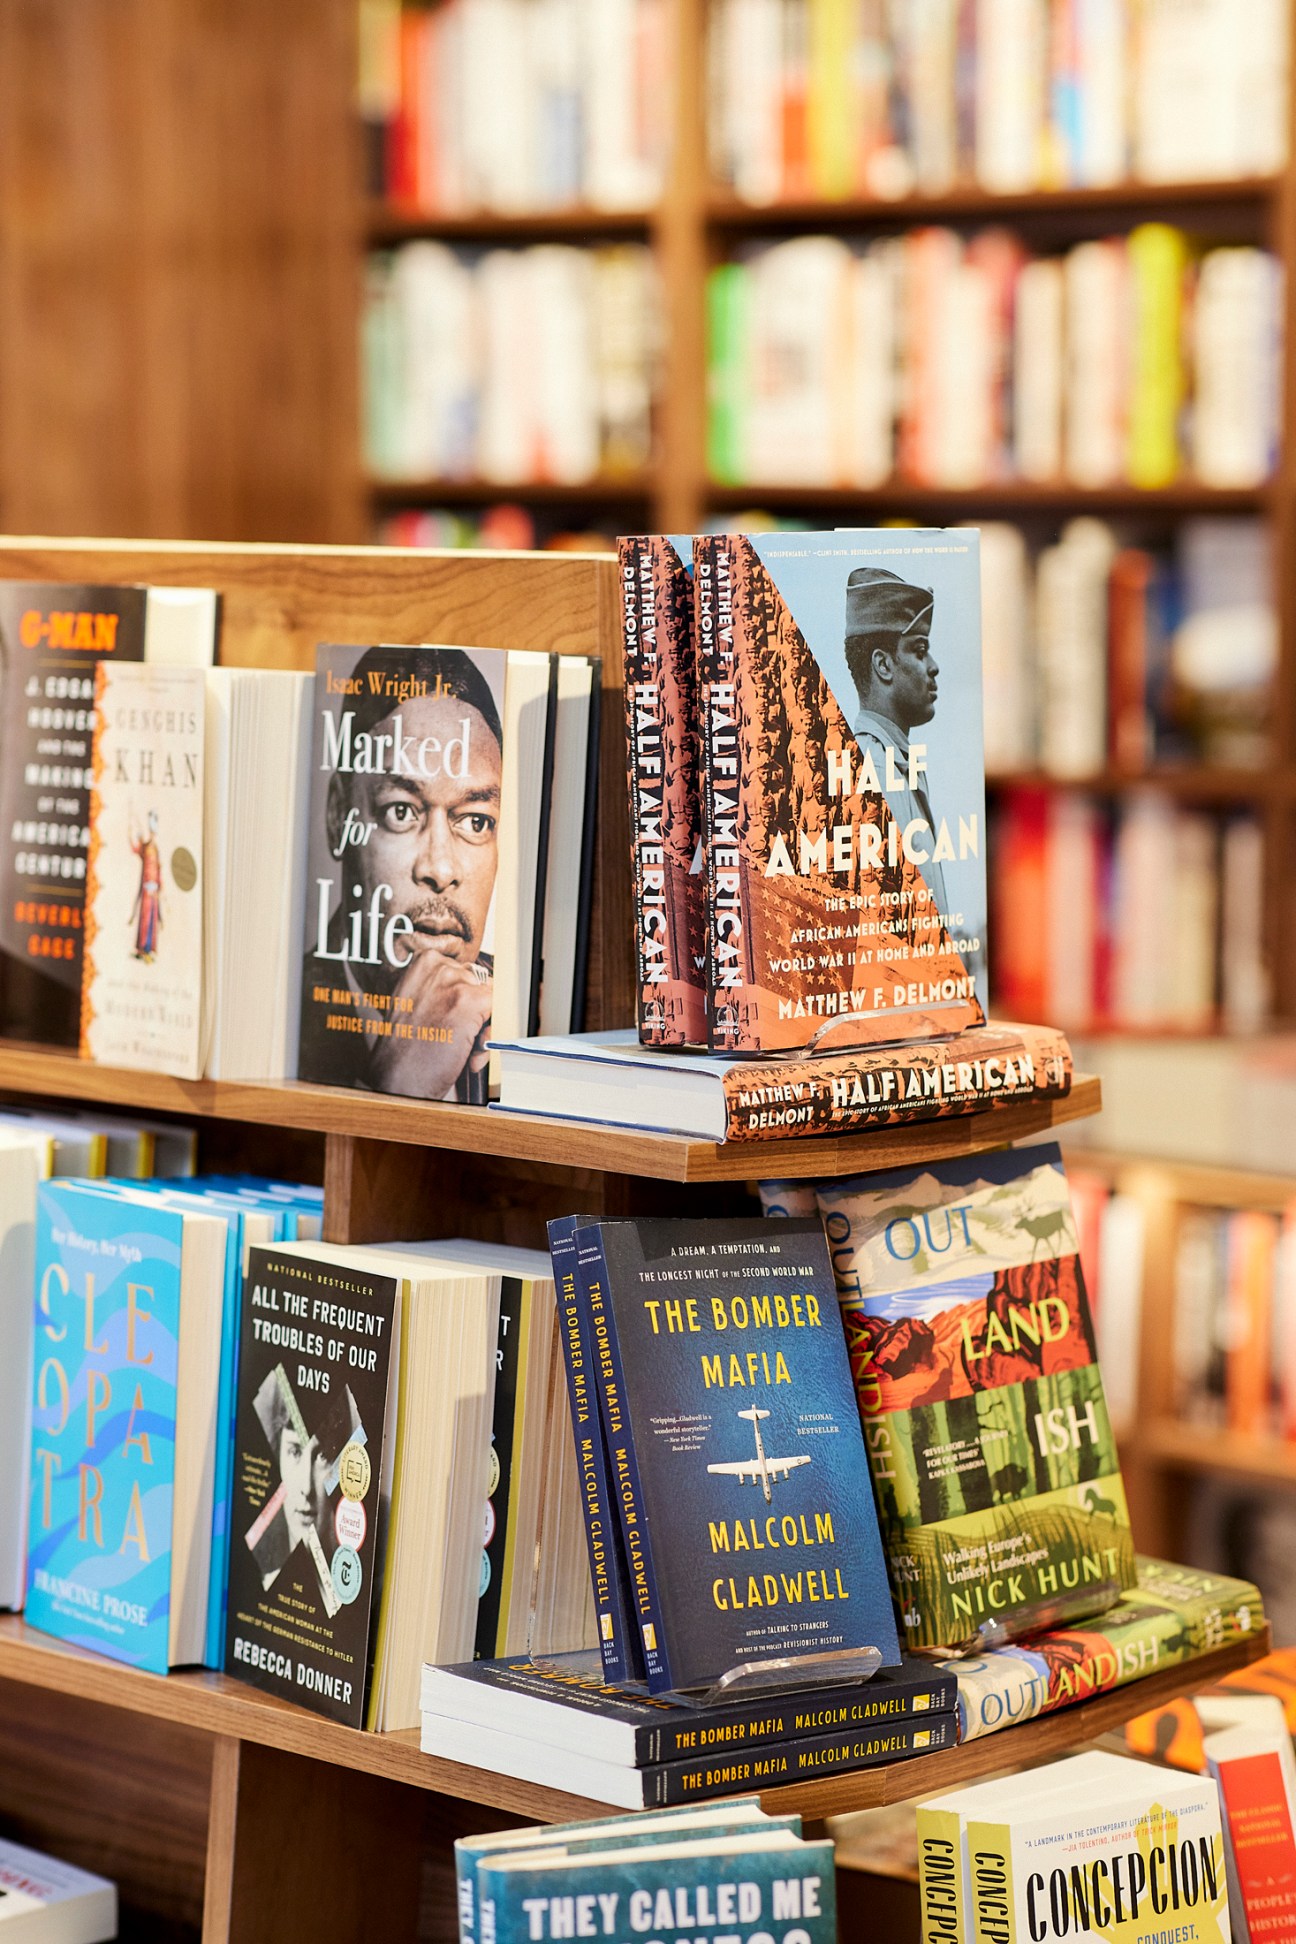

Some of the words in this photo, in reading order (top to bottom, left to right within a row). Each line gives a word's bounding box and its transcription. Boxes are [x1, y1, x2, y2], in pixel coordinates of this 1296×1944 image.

[623, 566, 638, 656] DELMONT
[639, 555, 657, 644] MATTHEW
[699, 564, 714, 656] DELMONT
[716, 552, 733, 643] MATTHEW
[20, 610, 118, 651] G-MAN
[643, 652, 657, 666] F.
[720, 651, 733, 665] F.
[326, 669, 363, 695] Isaac
[368, 671, 428, 704] Wright
[433, 674, 457, 701] Jr.
[320, 710, 472, 778] Marked
[635, 684, 661, 774] HALF
[710, 684, 737, 775] HALF
[115, 749, 198, 788] KHAN
[827, 744, 927, 796] HALF
[333, 807, 378, 856] for
[764, 814, 978, 877] AMERICAN
[638, 790, 669, 983] AMERICAN
[713, 792, 743, 987] AMERICAN
[825, 897, 846, 911] THE
[849, 894, 876, 908] EPIC
[880, 890, 914, 906] STORY
[917, 889, 934, 902] OF
[313, 878, 414, 968] Life
[790, 924, 844, 943] AFRICAN
[845, 919, 908, 939] AMERICANS
[911, 912, 964, 933] FIGHTING
[769, 957, 815, 973] WORLD
[819, 954, 843, 967] WAR
[847, 951, 857, 965] II
[860, 950, 873, 964] AT
[877, 946, 910, 962] HOME
[912, 942, 935, 958] AND
[938, 938, 980, 956] ABROAD
[313, 986, 330, 1003] ONE
[363, 992, 391, 1009] FIGHT
[394, 996, 413, 1012] FOR
[778, 989, 865, 1019] MATTHEW
[873, 987, 887, 1008] F.
[894, 976, 976, 1006] DELMONT
[326, 1014, 363, 1033] JUSTICE
[365, 1018, 392, 1037] FROM
[395, 1023, 413, 1039] THE
[417, 1026, 453, 1043] INSIDE
[739, 1084, 804, 1108] MATTHEW
[808, 1083, 820, 1098] F.
[831, 1071, 896, 1108] HALF
[906, 1053, 1036, 1099] AMERICAN
[749, 1106, 814, 1130] DELMONT
[671, 1247, 677, 1257] A
[711, 1245, 717, 1255] A
[769, 1245, 780, 1253] AND
[885, 1205, 973, 1260] OUT
[267, 1262, 313, 1281] NATIONAL
[317, 1275, 374, 1296] BESTSELLER
[562, 1272, 576, 1301] THE
[589, 1281, 603, 1311] THE
[639, 1272, 655, 1282] THE
[657, 1269, 692, 1282] LONGEST
[695, 1268, 719, 1279] NIGHT
[741, 1267, 770, 1278] SECOND
[772, 1267, 797, 1277] WORLD
[798, 1266, 814, 1276] WAR
[252, 1285, 280, 1312] ALL
[283, 1291, 308, 1318] THE
[313, 1300, 385, 1338] FREQUENT
[643, 1298, 701, 1335] THE
[710, 1294, 822, 1331] BOMBER
[960, 1296, 1070, 1361] LAND
[253, 1318, 323, 1357] TROUBLES
[327, 1339, 345, 1362] OF
[348, 1345, 377, 1372] OUR
[566, 1306, 582, 1369] BOMBER
[594, 1316, 613, 1379] BOMBER
[297, 1365, 330, 1394] DAYS
[701, 1351, 792, 1389] MAFIA
[574, 1374, 589, 1423] MAFIA
[605, 1383, 623, 1433] MAFIA
[799, 1413, 833, 1422] NATIONAL
[797, 1426, 839, 1435] BESTSELLER
[1034, 1400, 1099, 1457] ISH
[581, 1438, 600, 1515] MALCOLM
[615, 1448, 637, 1525] MALCOLM
[339, 1524, 361, 1540] Winner
[341, 1514, 361, 1529] Award
[708, 1512, 835, 1553] MALCOLM
[590, 1520, 609, 1604] GLADWELL
[943, 1544, 988, 1566] Walking
[987, 1531, 1032, 1555] Europe's
[946, 1563, 990, 1585] Unlikely
[990, 1547, 1049, 1574] Landscapes
[628, 1530, 651, 1615] GLADWELL
[712, 1568, 849, 1611] GLADWELL
[951, 1574, 1026, 1620] NICK
[1037, 1547, 1118, 1596] HUNT
[103, 1594, 148, 1627] PROSE
[767, 1625, 789, 1634] TALKING
[790, 1624, 798, 1632] TO
[800, 1621, 829, 1631] STRANGERS
[326, 1646, 334, 1656] TO
[334, 1650, 354, 1663] HITLER
[647, 1651, 658, 1660] BACK
[783, 1638, 818, 1648] REVISIONIST
[820, 1636, 843, 1645] HISTORY
[233, 1637, 292, 1681] REBECCA
[296, 1663, 352, 1705] DONNER
[649, 1666, 663, 1675] BOOKS
[981, 1636, 1160, 1726] OUTLANDISH
[675, 1732, 696, 1749] THE
[700, 1725, 745, 1744] BOMBER
[749, 1717, 784, 1736] MAFIA
[795, 1707, 848, 1729] MALCOLM
[851, 1698, 906, 1720] GLADWELL
[682, 1773, 702, 1790] THE
[706, 1766, 750, 1786] BOMBER
[754, 1757, 788, 1776] MAFIA
[798, 1747, 850, 1768] MALCOLM
[853, 1735, 908, 1758] GLADWELL
[1033, 1835, 1065, 1847] LANDMARK
[1074, 1830, 1085, 1838] THE
[1086, 1821, 1128, 1836] CONTEMPORARY
[1129, 1815, 1160, 1828] LITERATURE
[1169, 1810, 1179, 1818] THE
[1111, 1832, 1131, 1843] AUTHOR
[459, 1878, 474, 1929] THEY
[522, 1892, 619, 1941] THEY
[629, 1881, 761, 1932] CALLED
[772, 1876, 822, 1920] ME
[922, 1838, 959, 1944] CONCEPC
[974, 1852, 1010, 1944] CONCEP
[1026, 1834, 1218, 1942] CONCEPCION
